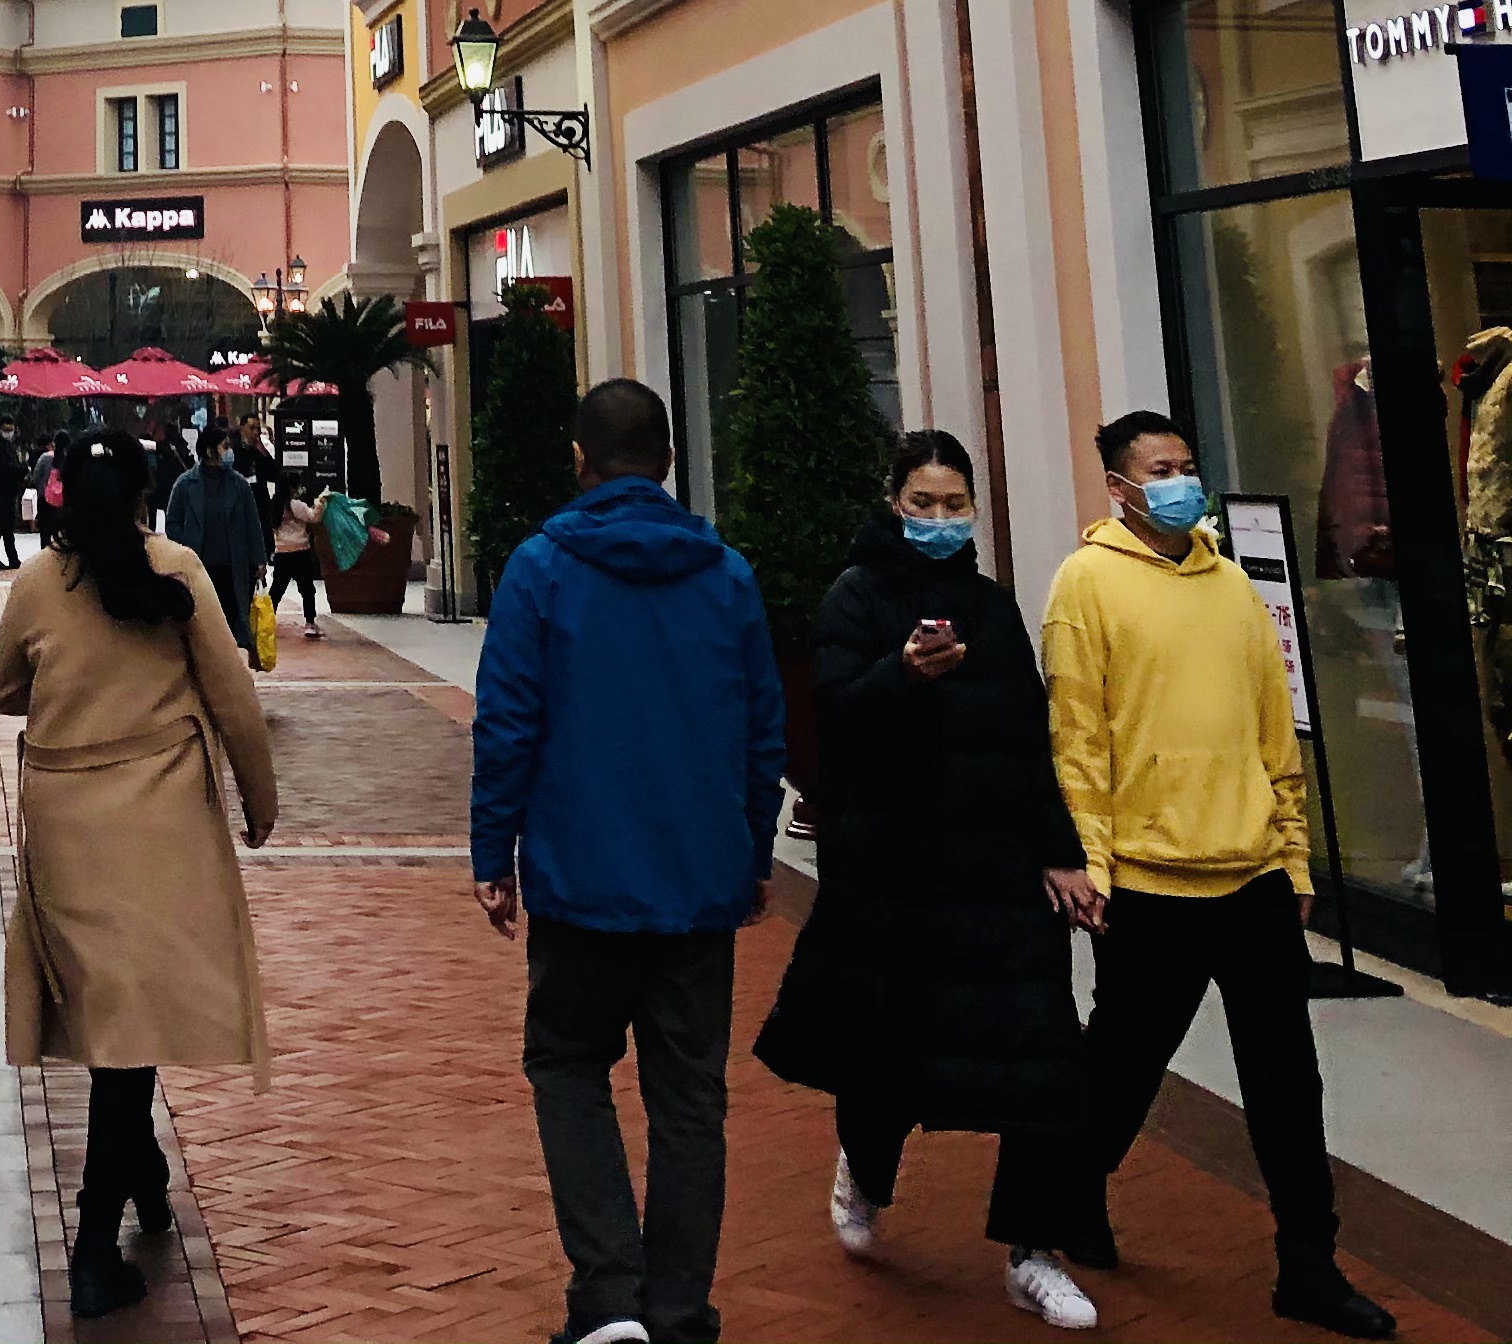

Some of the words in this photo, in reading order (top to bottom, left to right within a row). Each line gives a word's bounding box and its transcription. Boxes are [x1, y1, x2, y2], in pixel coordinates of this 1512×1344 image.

[369, 24, 390, 83] FILA
[1346, 3, 1451, 64] TOMMY
[115, 207, 195, 232] Kappa
[414, 317, 448, 330] FILA
